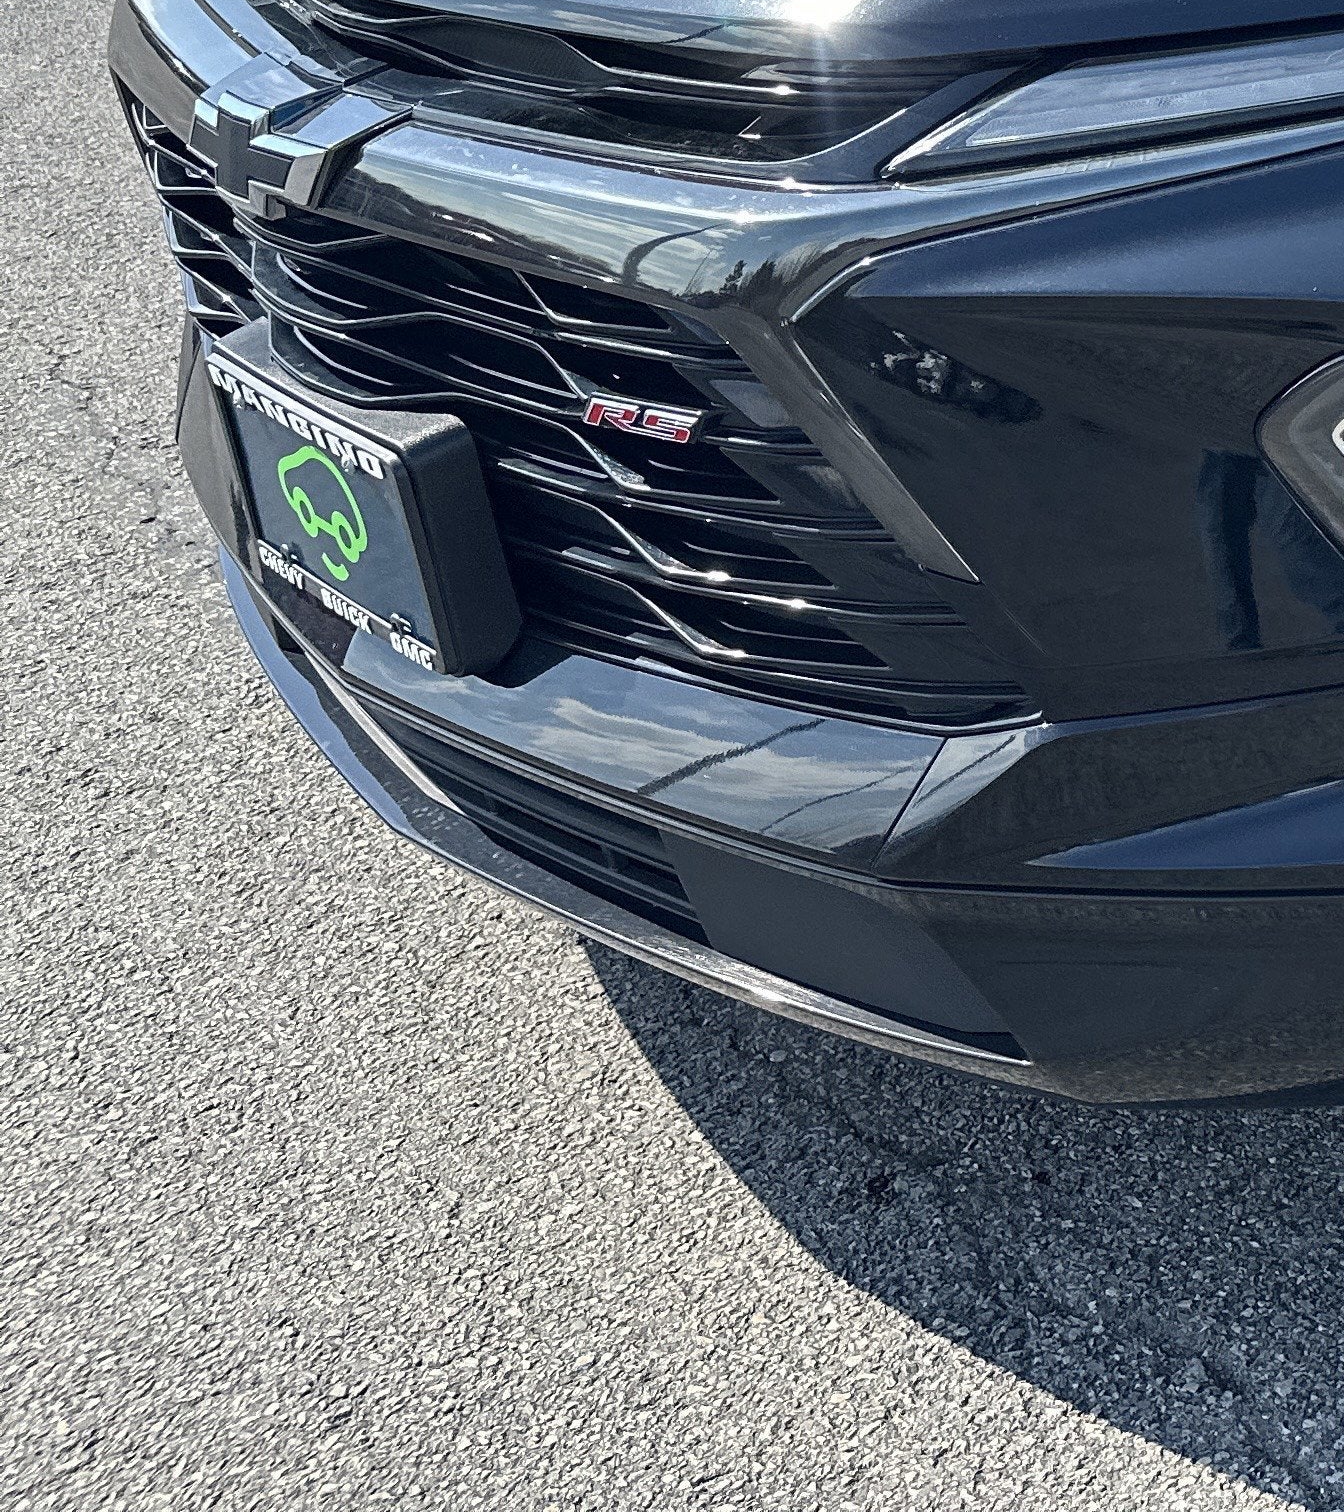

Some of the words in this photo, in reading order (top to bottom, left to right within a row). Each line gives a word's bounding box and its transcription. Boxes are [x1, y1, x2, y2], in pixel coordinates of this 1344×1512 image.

[207, 363, 384, 480] MANGINO
[582, 396, 699, 444] RS
[258, 546, 304, 590] CHEVY
[320, 588, 372, 635] BUICK
[389, 631, 433, 671] GMC
